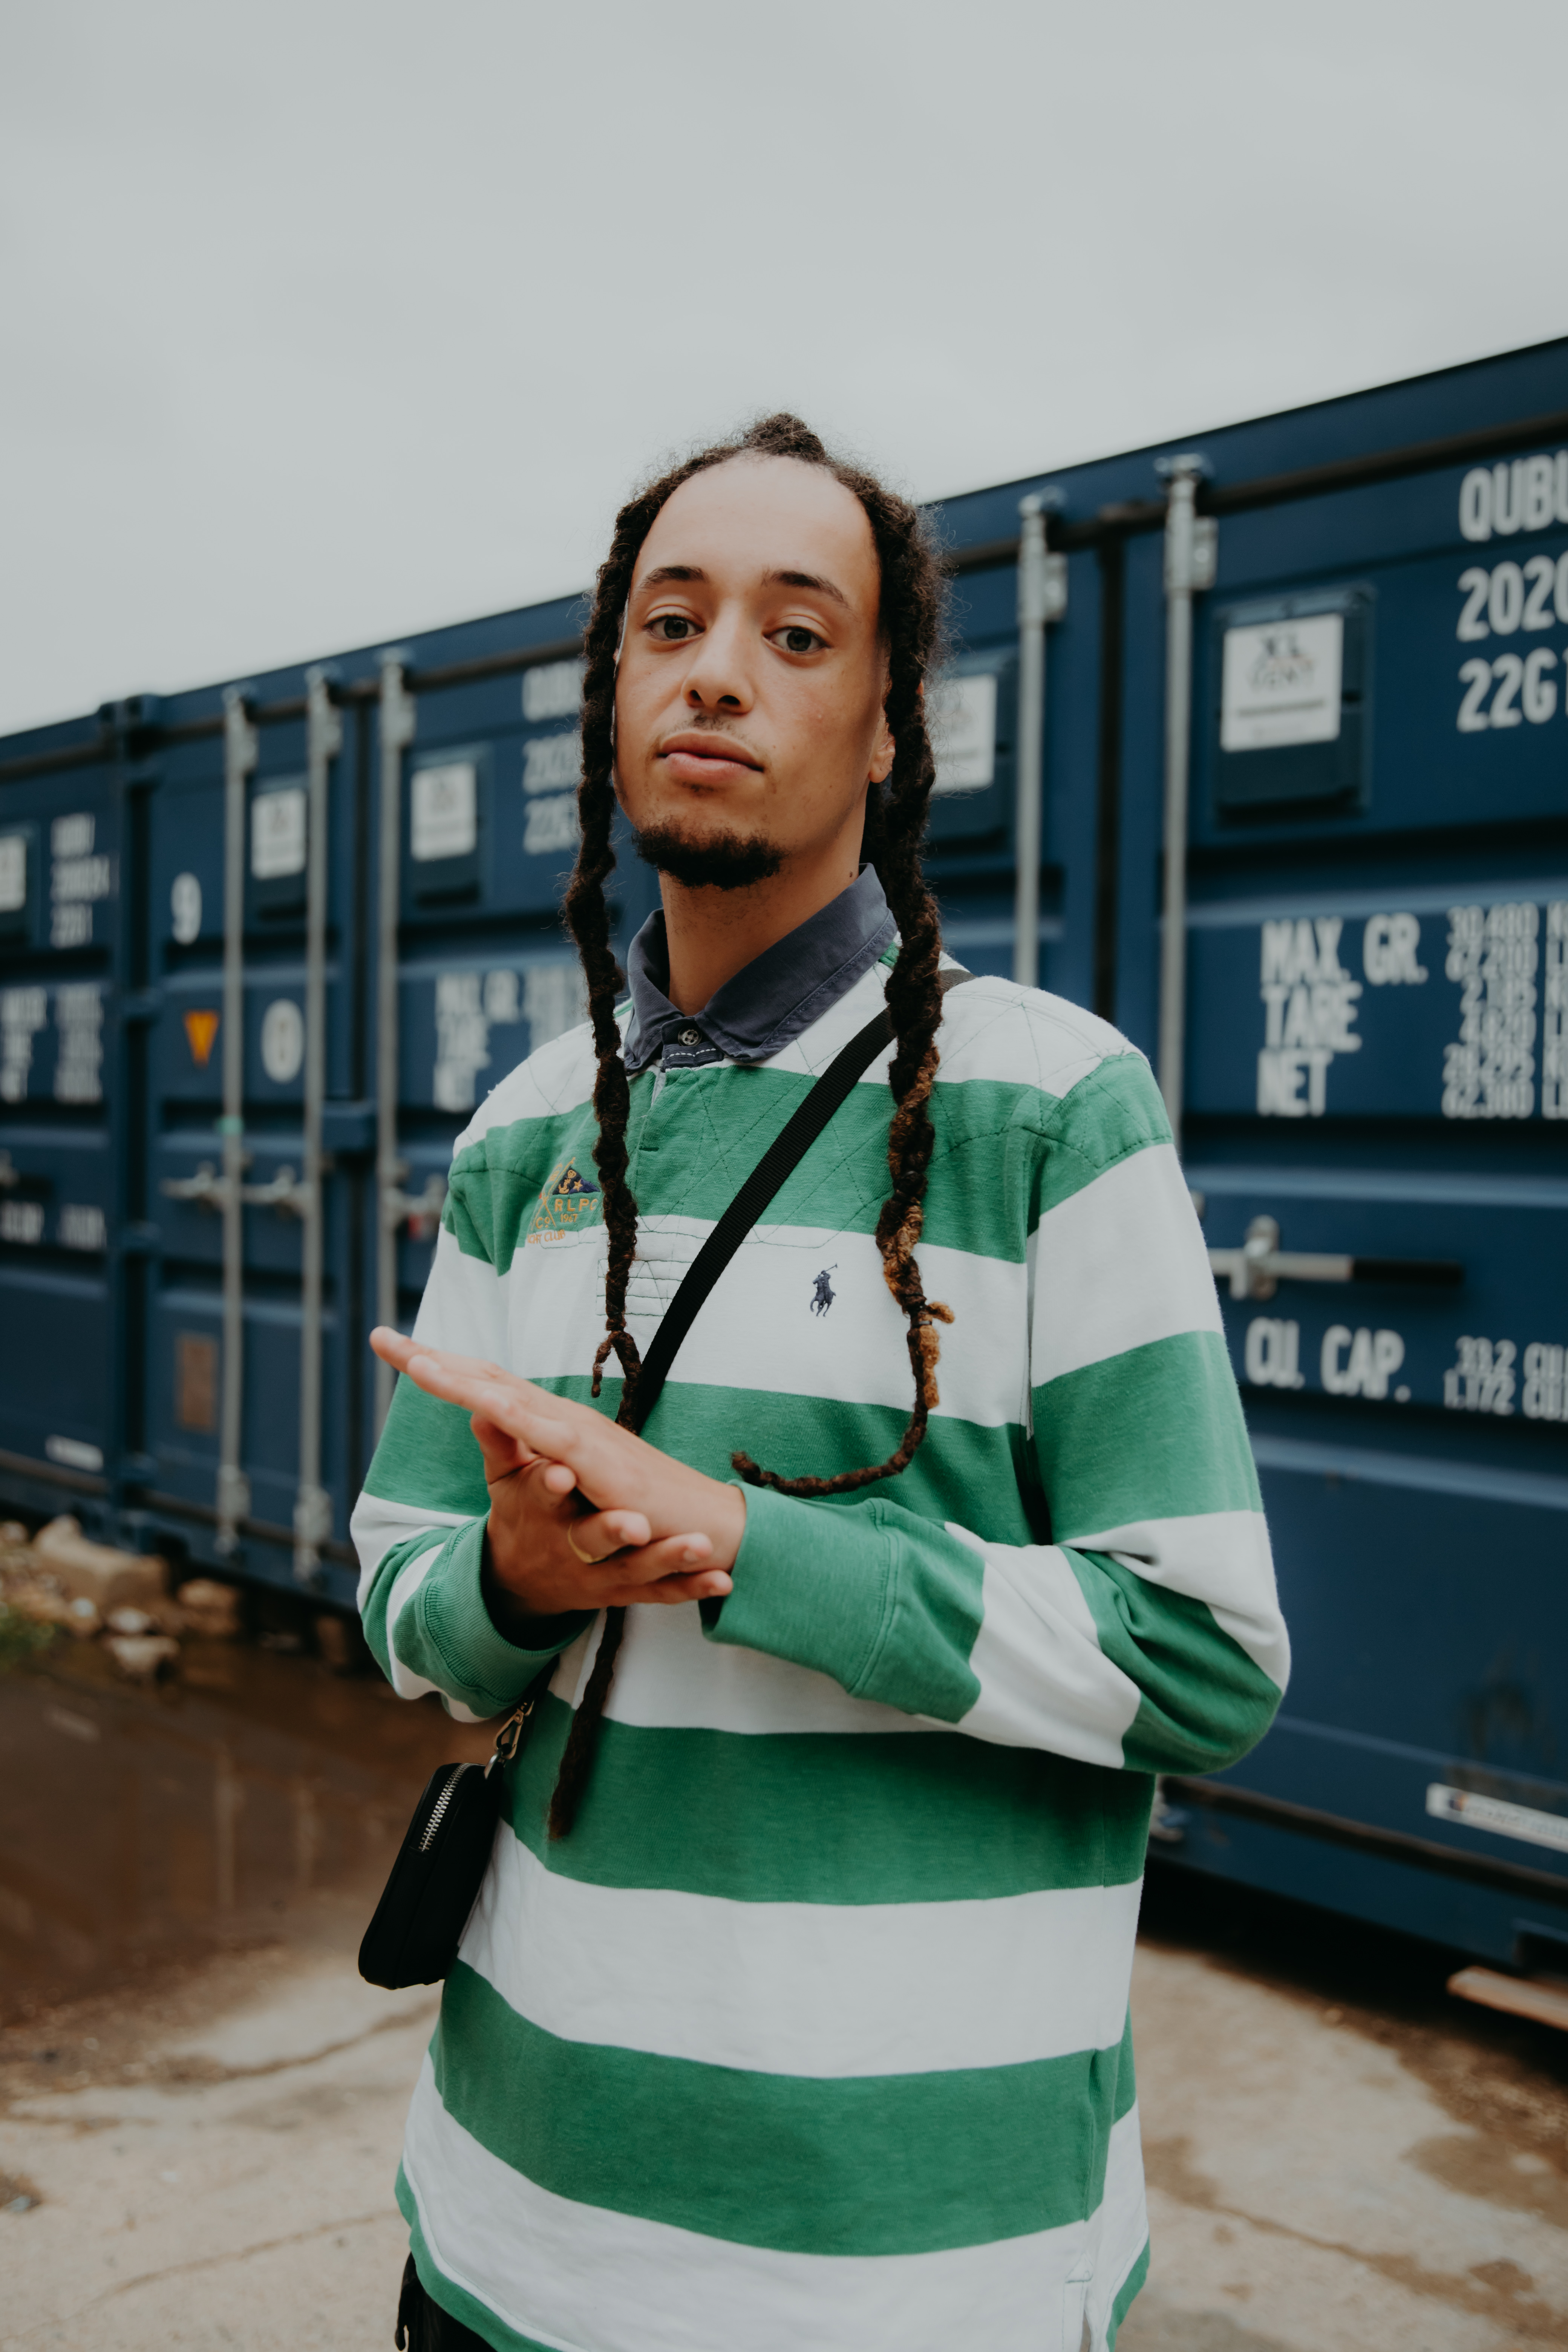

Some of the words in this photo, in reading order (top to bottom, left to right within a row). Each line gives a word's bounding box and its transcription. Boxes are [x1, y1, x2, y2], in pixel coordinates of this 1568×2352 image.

[1261, 980, 1363, 1052] TARE
[1257, 1047, 1334, 1117] NET
[544, 1230, 565, 1242] CLUB
[560, 1214, 577, 1222] 1967
[1321, 1325, 1411, 1403] CAP.
